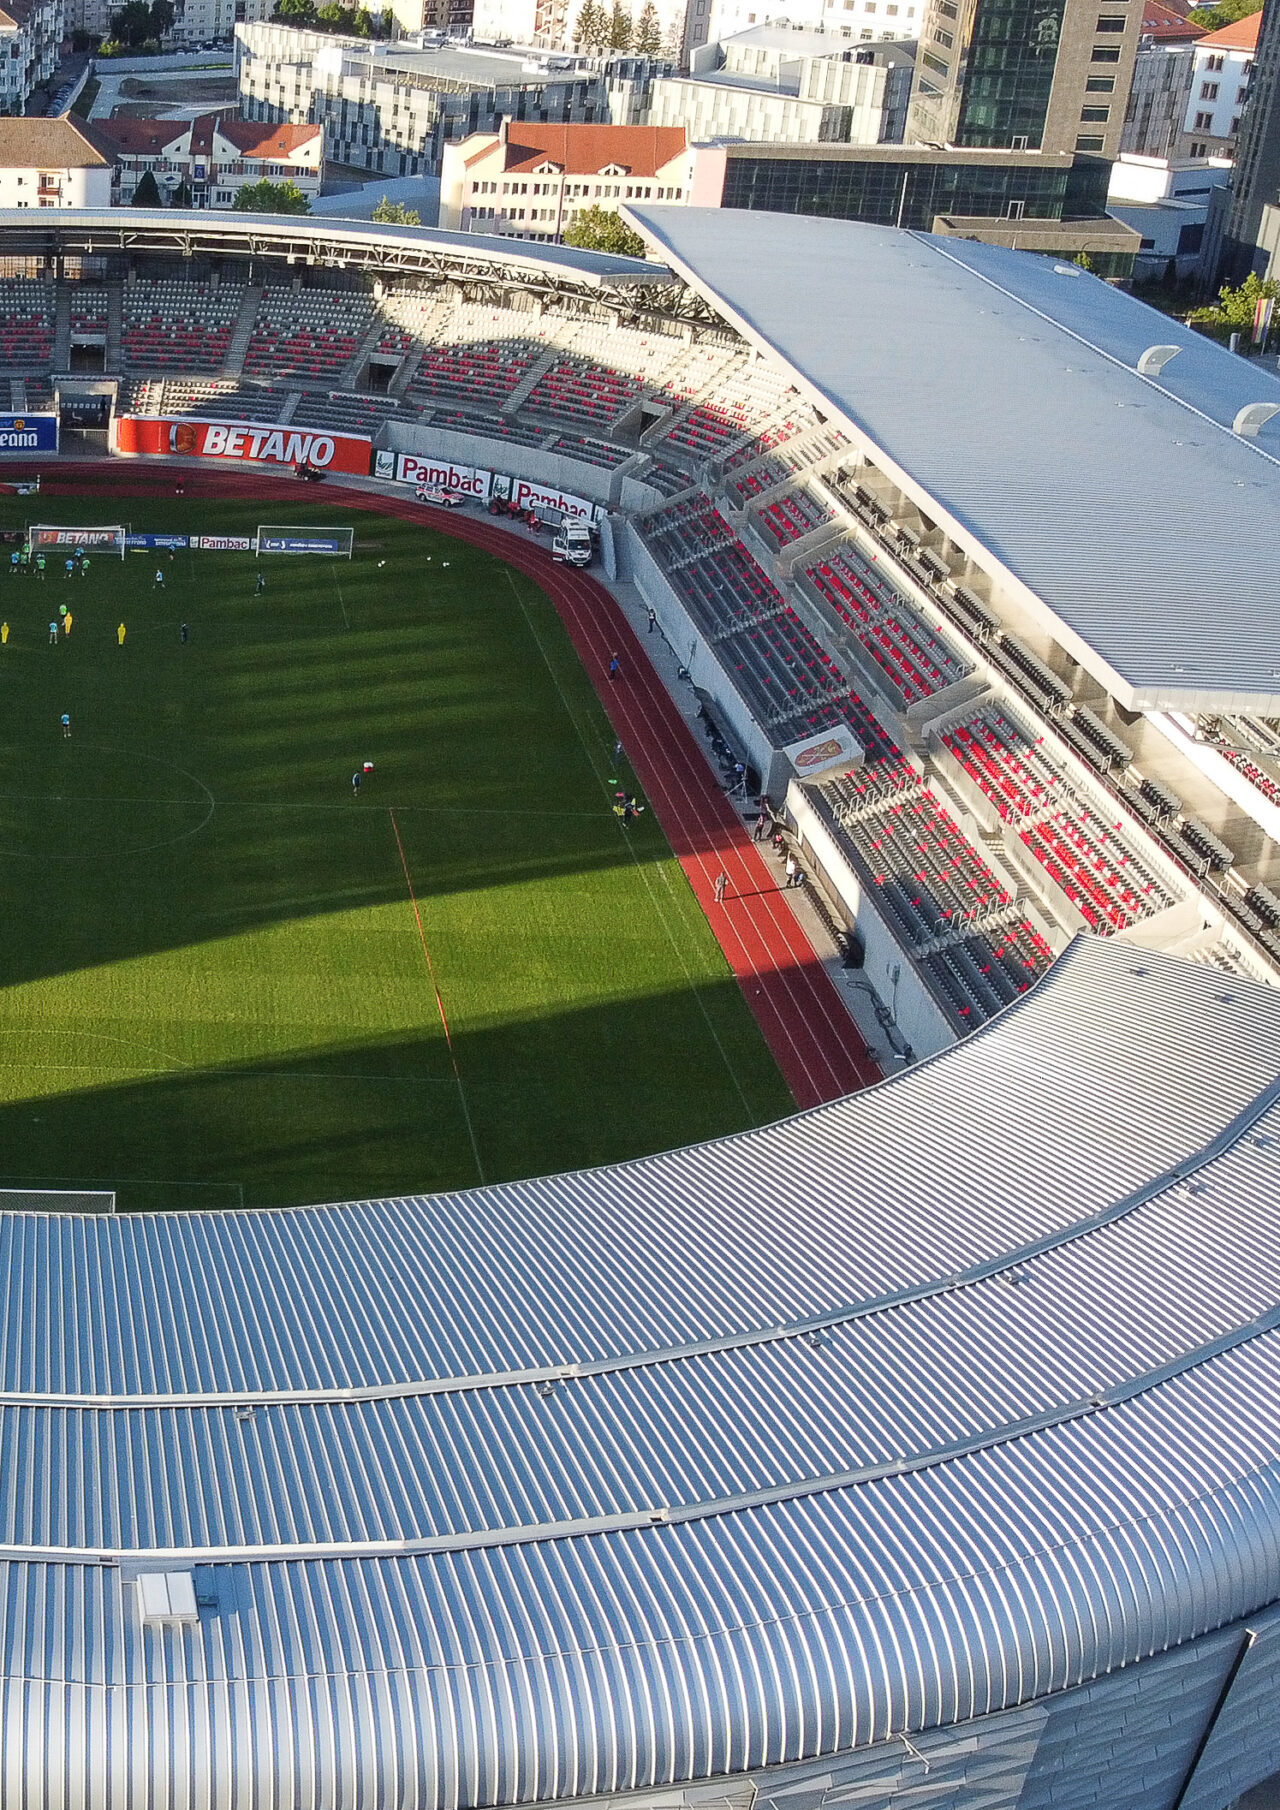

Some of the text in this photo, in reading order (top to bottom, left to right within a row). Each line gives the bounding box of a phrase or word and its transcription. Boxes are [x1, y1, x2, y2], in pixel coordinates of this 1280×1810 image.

[203, 424, 335, 467] BETANO
[402, 458, 484, 494] Pambac
[201, 537, 248, 549] Pambac
